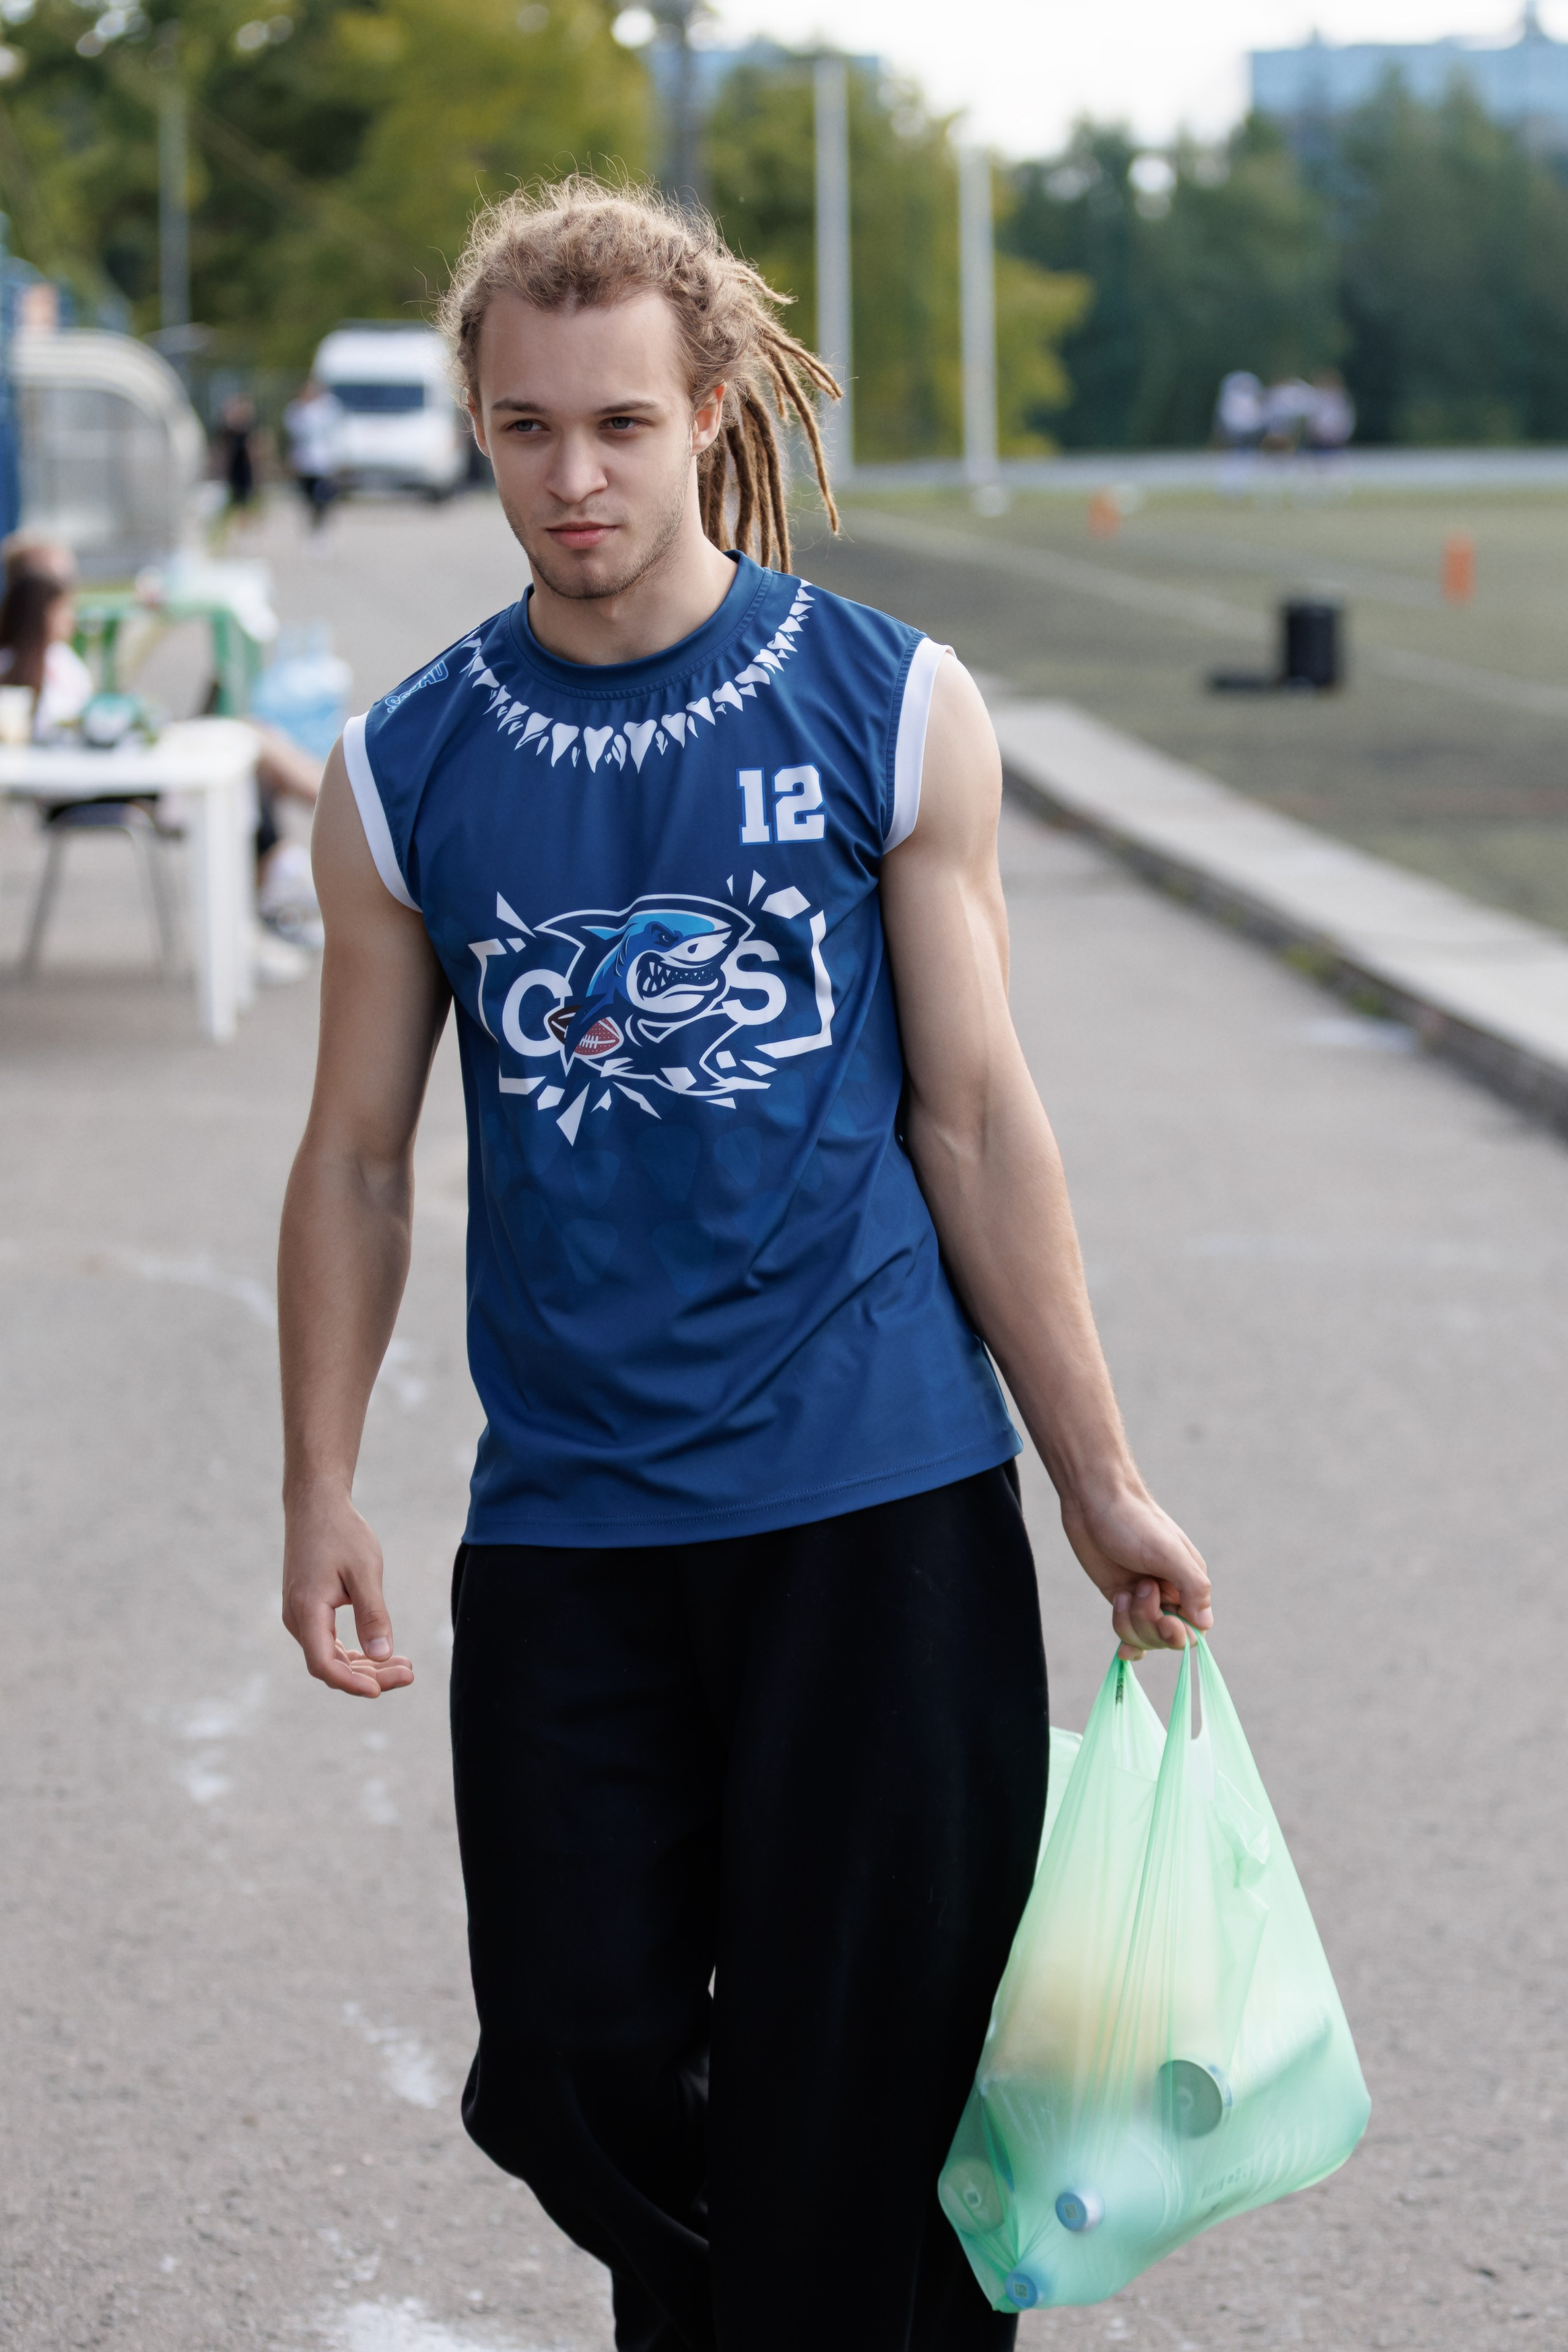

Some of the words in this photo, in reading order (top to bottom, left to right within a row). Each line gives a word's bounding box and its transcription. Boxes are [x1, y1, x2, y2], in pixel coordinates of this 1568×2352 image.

[737, 763, 826, 845] 12
[502, 968, 573, 1057] C
[722, 940, 787, 1025] S
